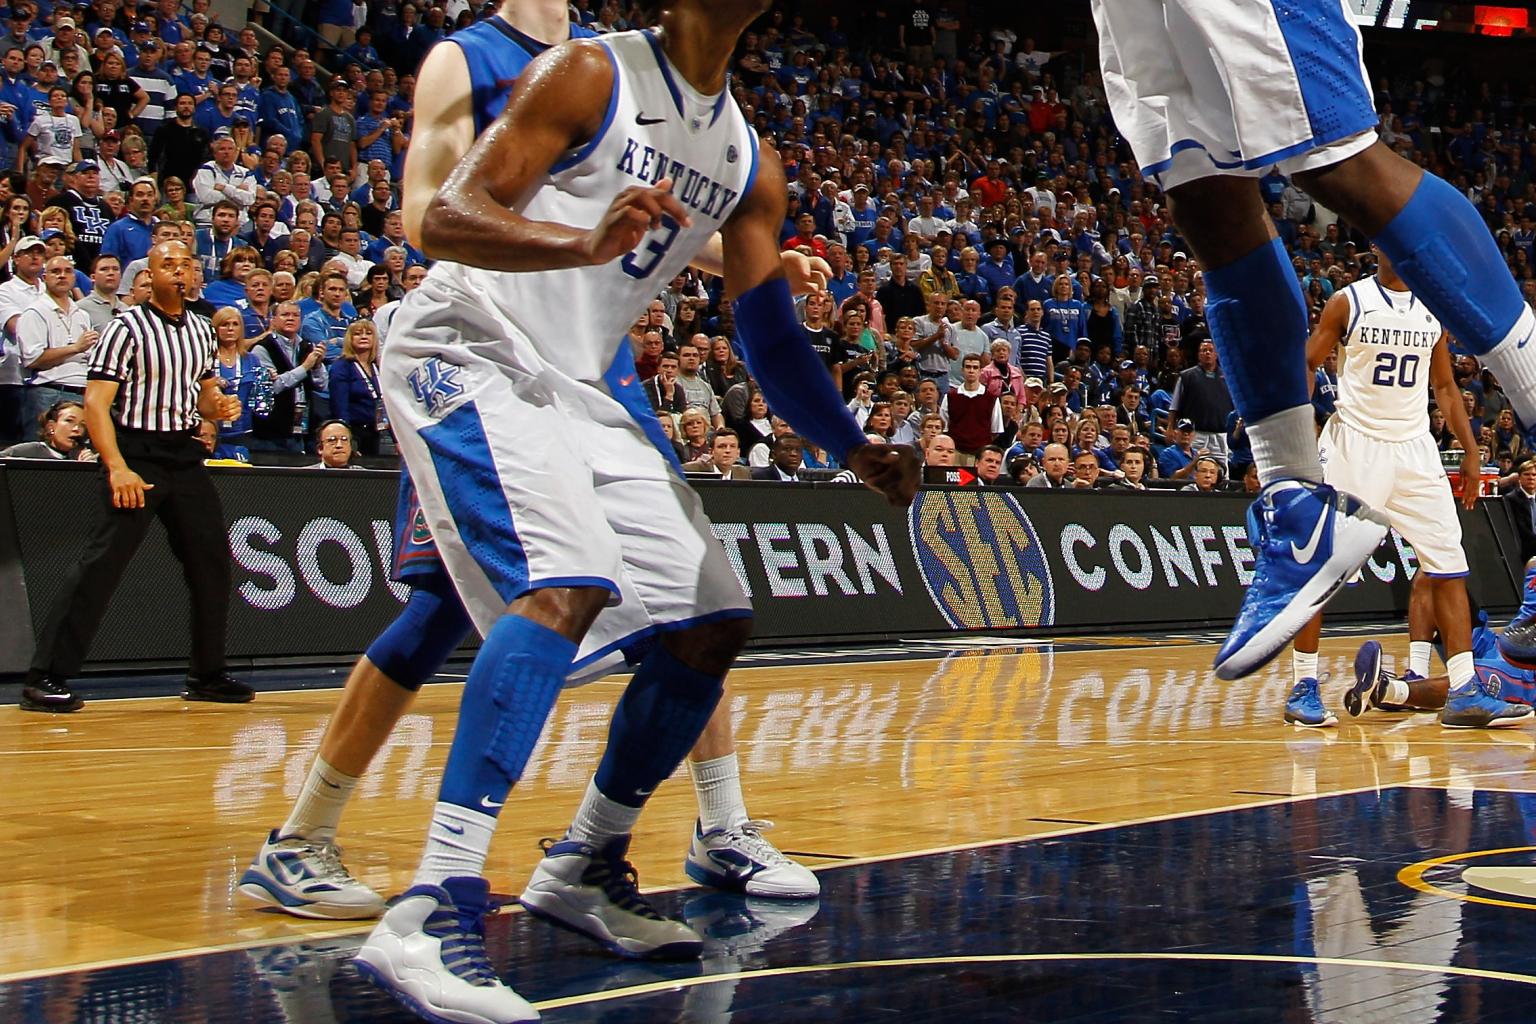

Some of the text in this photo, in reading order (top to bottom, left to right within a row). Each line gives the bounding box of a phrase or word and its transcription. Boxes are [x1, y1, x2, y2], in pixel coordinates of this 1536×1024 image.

[616, 137, 738, 220] KENTUCKY
[620, 213, 681, 280] 3
[1359, 326, 1438, 348] KENTUCKY
[1371, 352, 1420, 388] 20
[914, 490, 1047, 629] SEC
